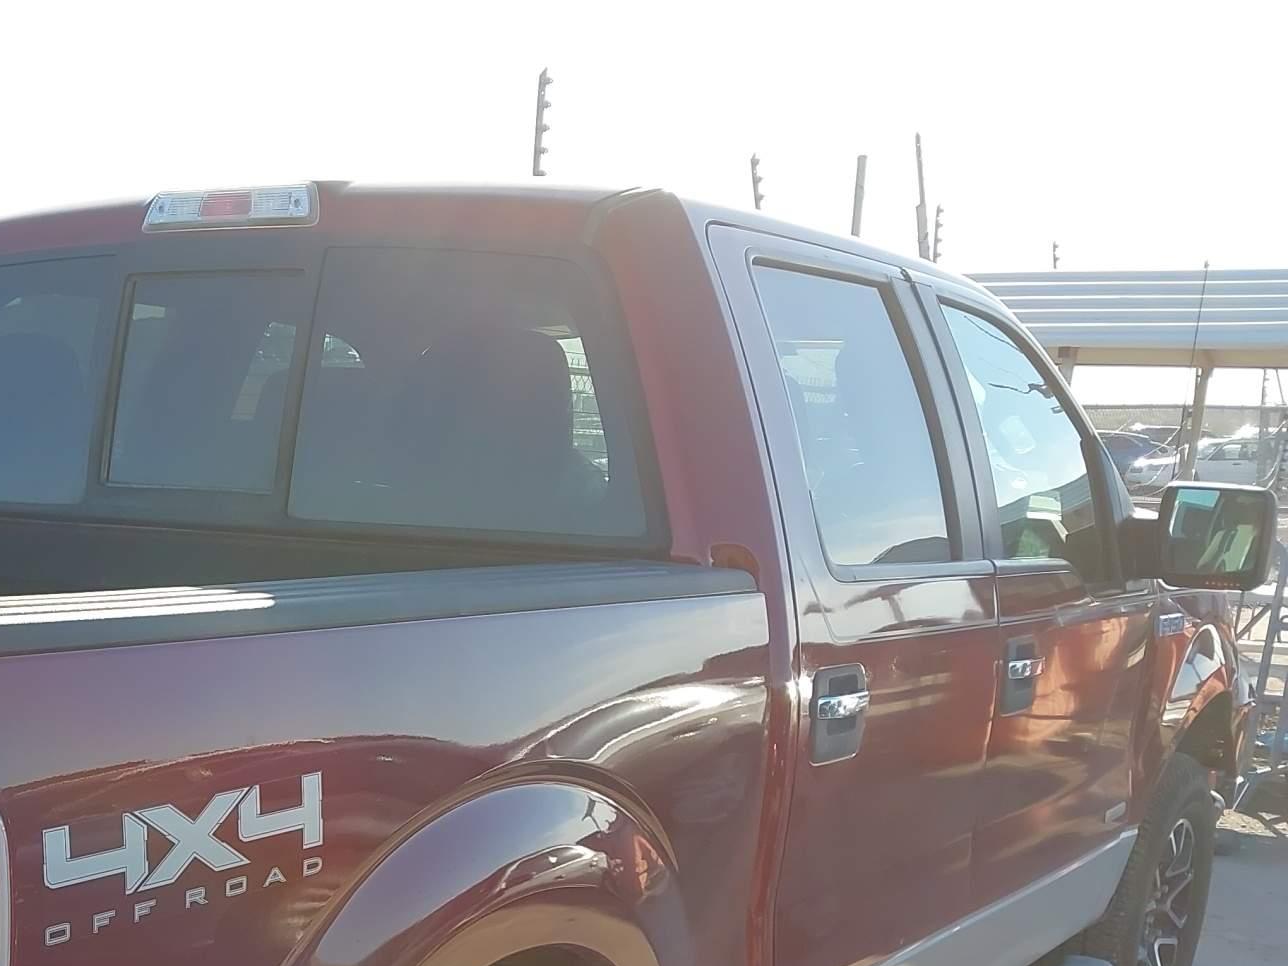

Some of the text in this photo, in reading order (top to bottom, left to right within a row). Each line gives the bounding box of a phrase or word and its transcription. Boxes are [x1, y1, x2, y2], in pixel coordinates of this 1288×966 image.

[42, 771, 323, 895] 4X4
[44, 856, 323, 946] OFF ROAD
